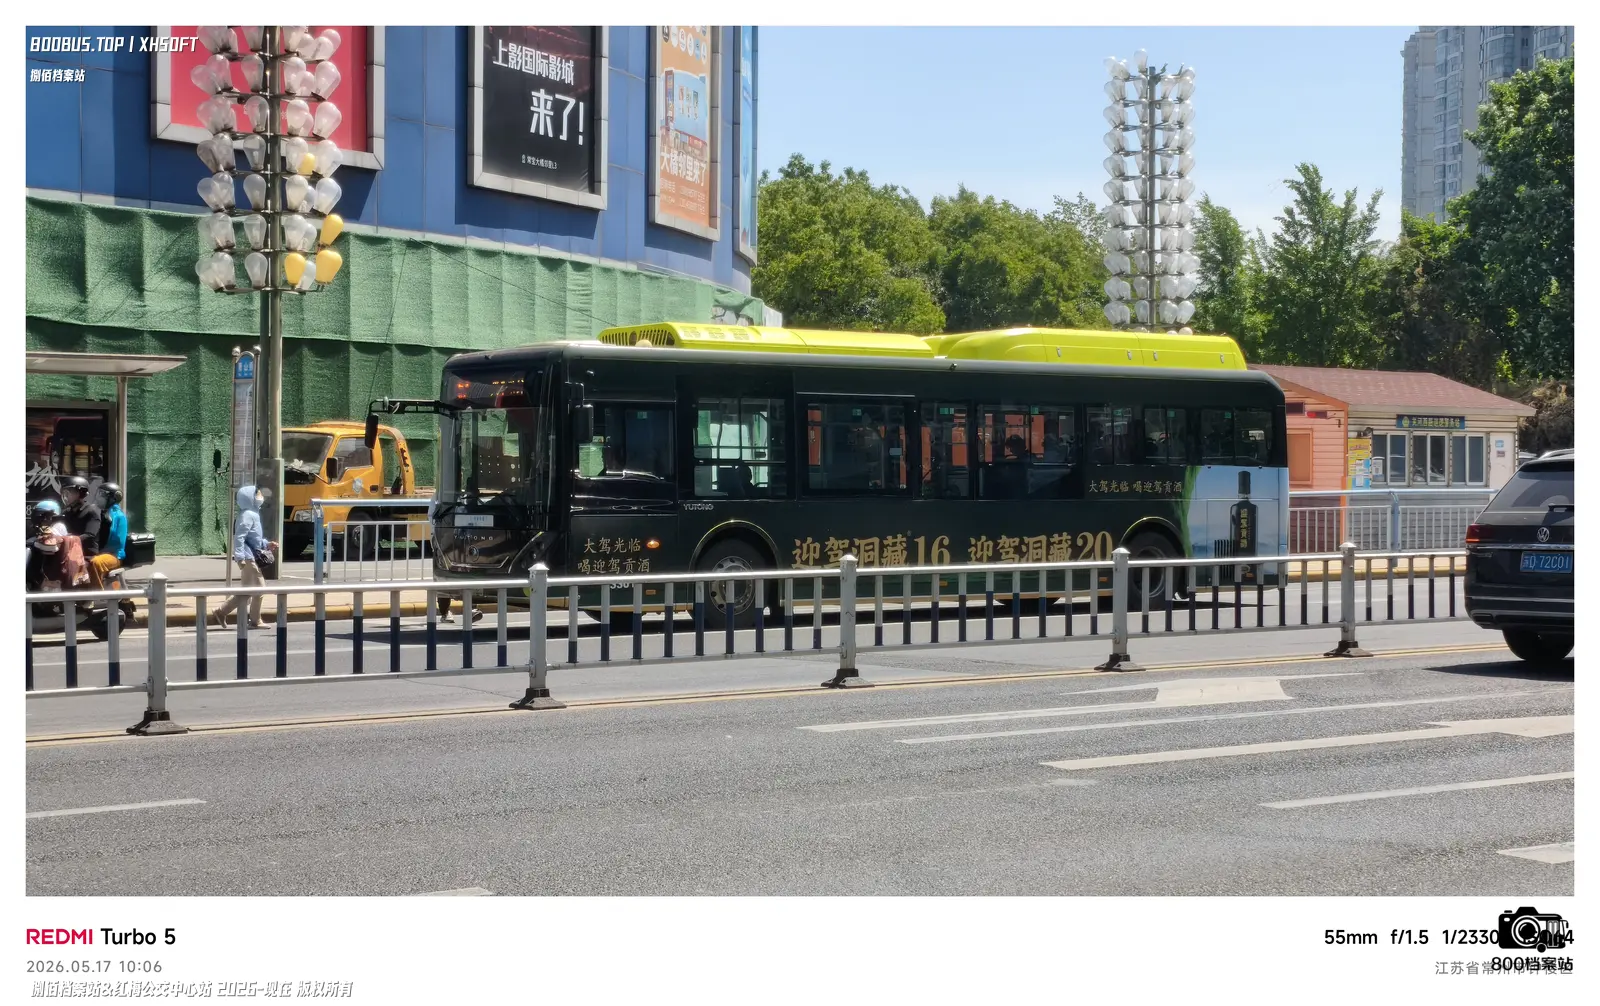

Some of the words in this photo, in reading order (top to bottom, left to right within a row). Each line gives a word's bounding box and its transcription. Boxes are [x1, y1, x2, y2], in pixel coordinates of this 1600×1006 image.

[492, 39, 574, 86] 上影国际影城
[1088, 480, 1129, 494] 大驾光临
[683, 503, 714, 511] YUTONG
[584, 537, 641, 554] 大驾光临
[577, 558, 650, 575] 喝迎驾贡酒
